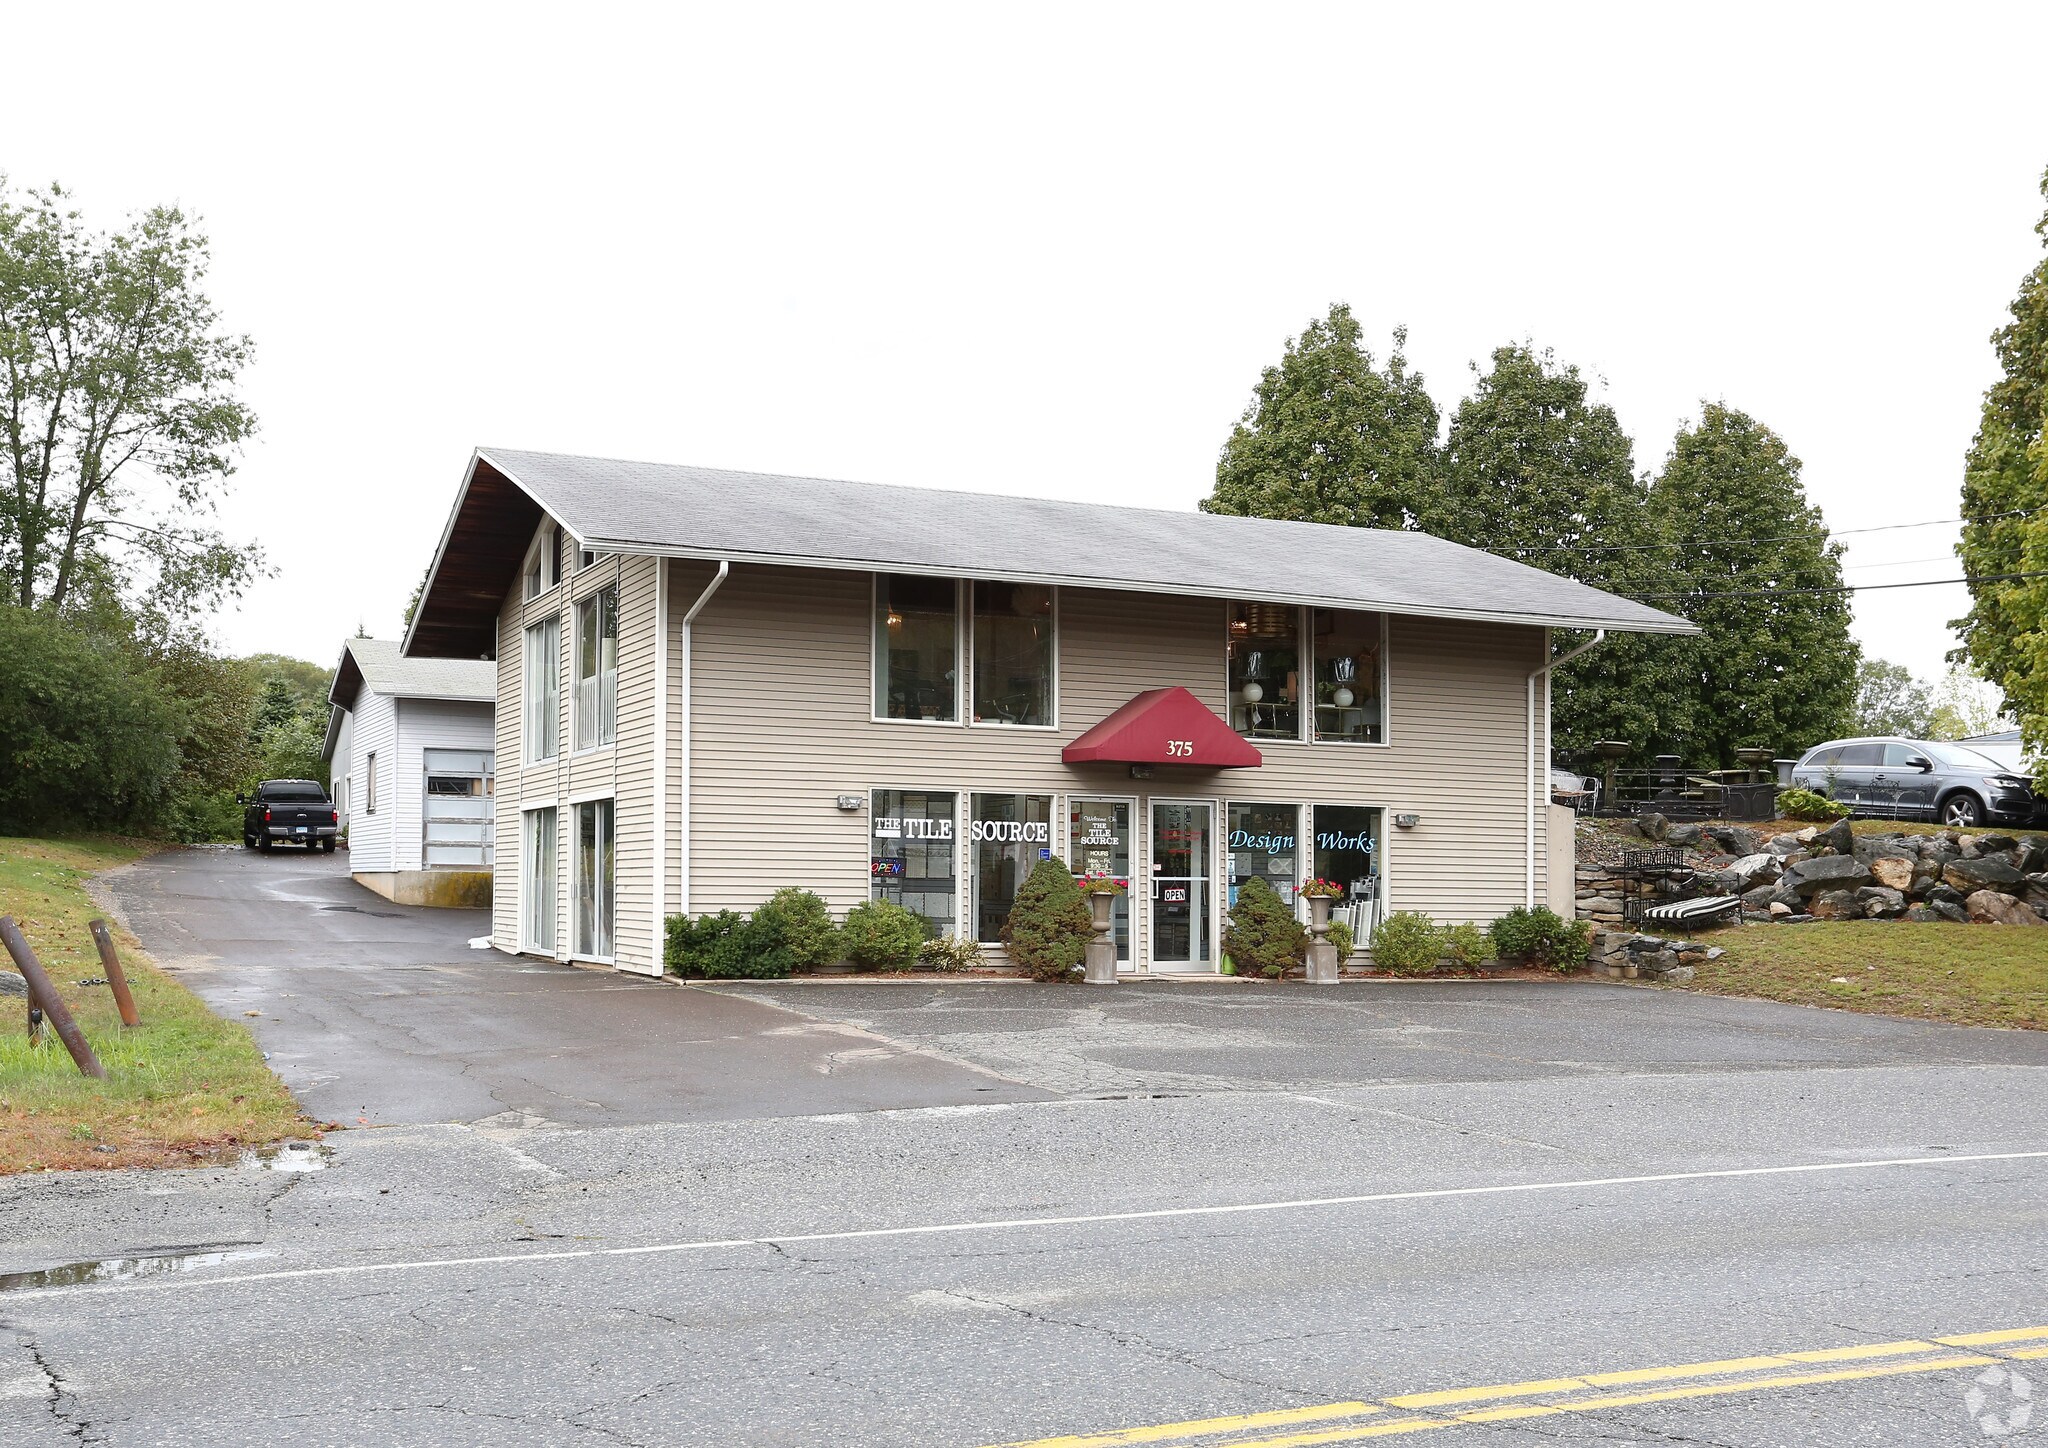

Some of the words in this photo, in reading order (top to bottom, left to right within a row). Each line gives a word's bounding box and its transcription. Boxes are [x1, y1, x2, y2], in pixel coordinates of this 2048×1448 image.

[1166, 740, 1193, 757] 375
[875, 818, 901, 829] THE
[903, 818, 952, 839] TILE
[971, 820, 1048, 842] SOURCE
[1089, 829, 1111, 837] TILE
[1081, 837, 1119, 845] SOURCE
[1229, 830, 1295, 854] Design
[1317, 831, 1376, 854] Works
[871, 863, 901, 874] OPEN
[1166, 891, 1185, 900] OPEN
